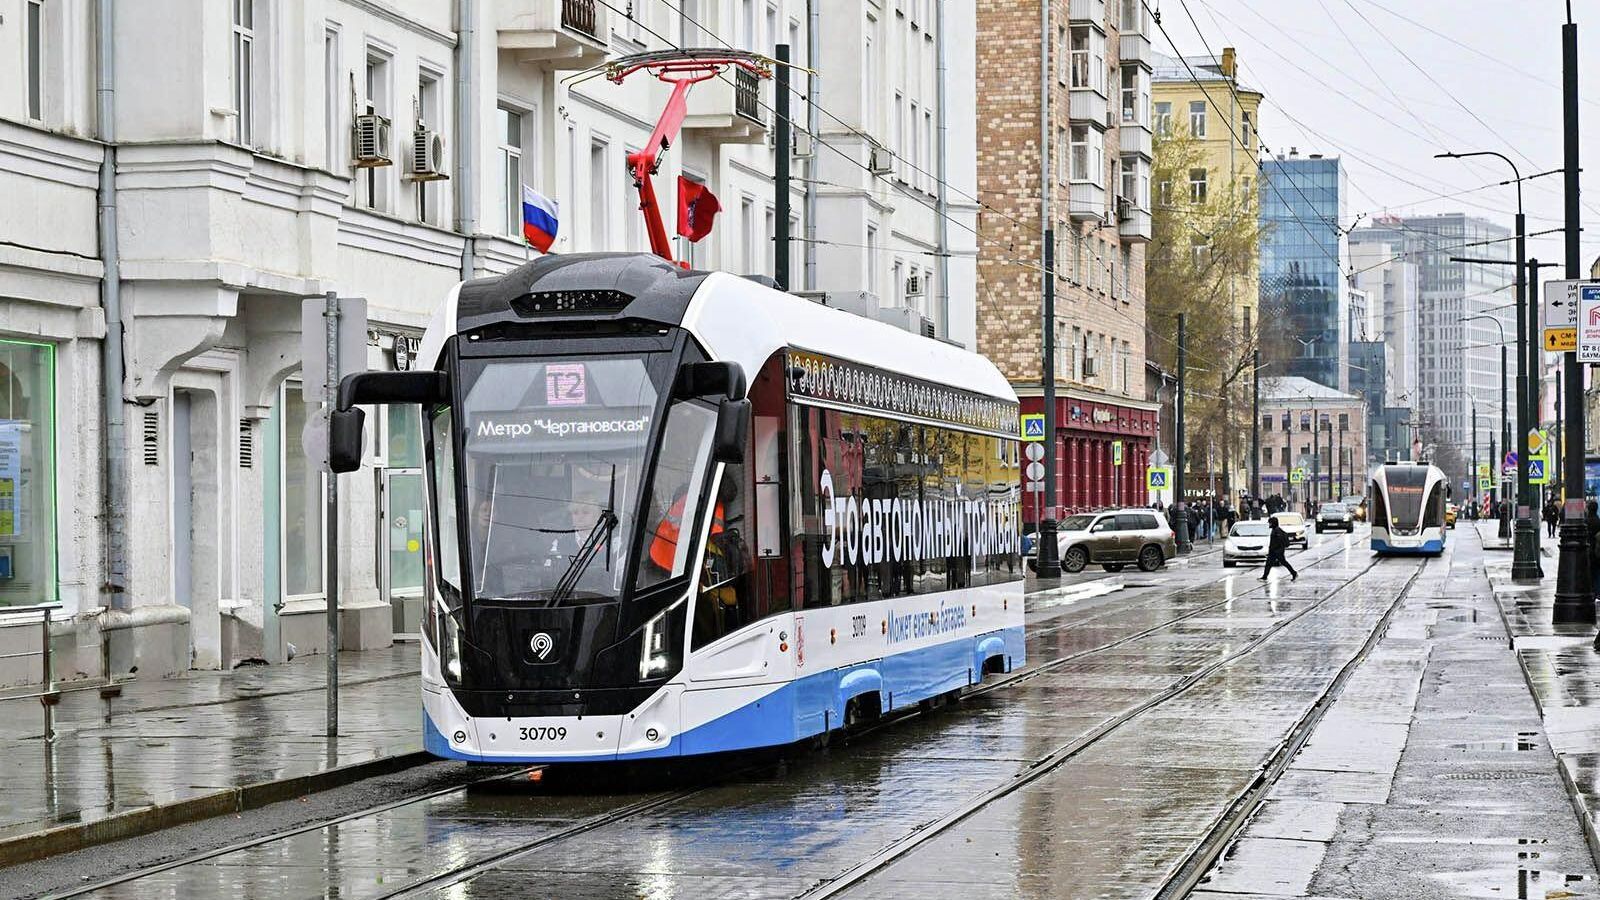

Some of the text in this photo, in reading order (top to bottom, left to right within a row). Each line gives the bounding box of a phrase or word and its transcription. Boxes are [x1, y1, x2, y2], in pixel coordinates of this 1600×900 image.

[477, 416, 649, 438] Метро "Чертановская"
[820, 469, 859, 569] Это
[862, 479, 964, 566] автономный
[886, 609, 912, 645] Может
[519, 727, 567, 741] 30709
